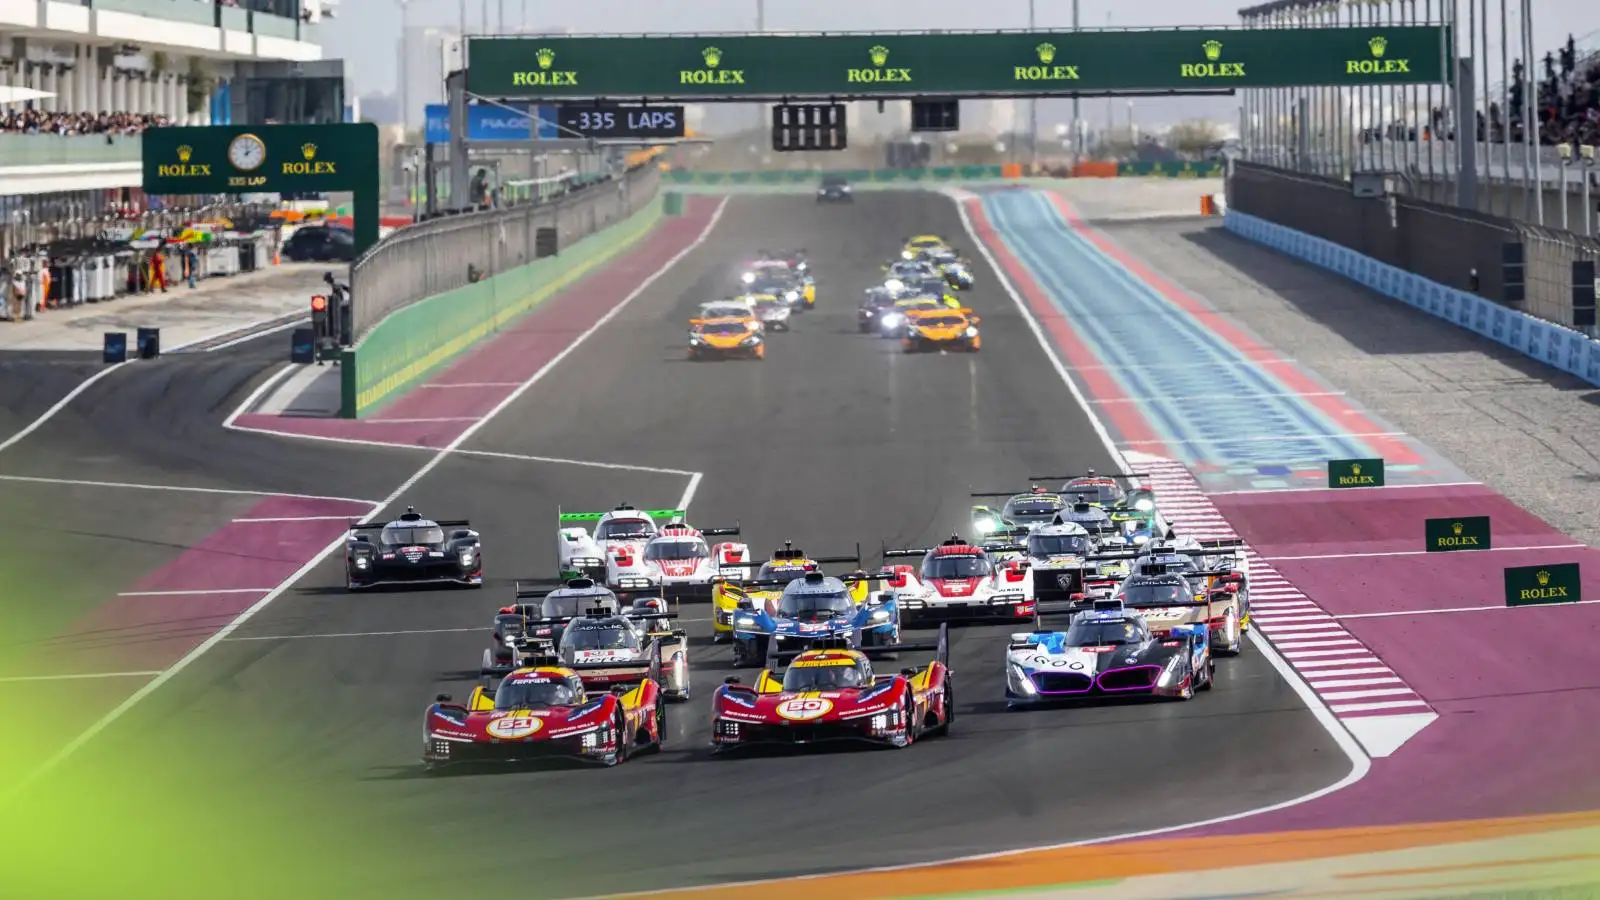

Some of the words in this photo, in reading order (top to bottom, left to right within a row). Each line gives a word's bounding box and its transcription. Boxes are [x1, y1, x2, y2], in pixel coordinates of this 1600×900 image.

[1014, 65, 1079, 81] ROLEX
[1180, 63, 1246, 78] ROLEX
[1346, 59, 1411, 75] ROLEX
[513, 71, 578, 87] ROLEX
[680, 70, 745, 85] ROLEX
[847, 69, 912, 83] ROLEX
[567, 112, 615, 131] -335
[627, 111, 677, 129] LAPS
[158, 164, 212, 177] ROLEX
[282, 162, 336, 175] ROLEX
[248, 176, 267, 186] LAP
[1339, 474, 1375, 486] ROLEX
[1437, 535, 1480, 547] ROLEX
[1520, 586, 1568, 600] ROLEX
[788, 700, 821, 712] 50
[498, 718, 532, 729] 51
